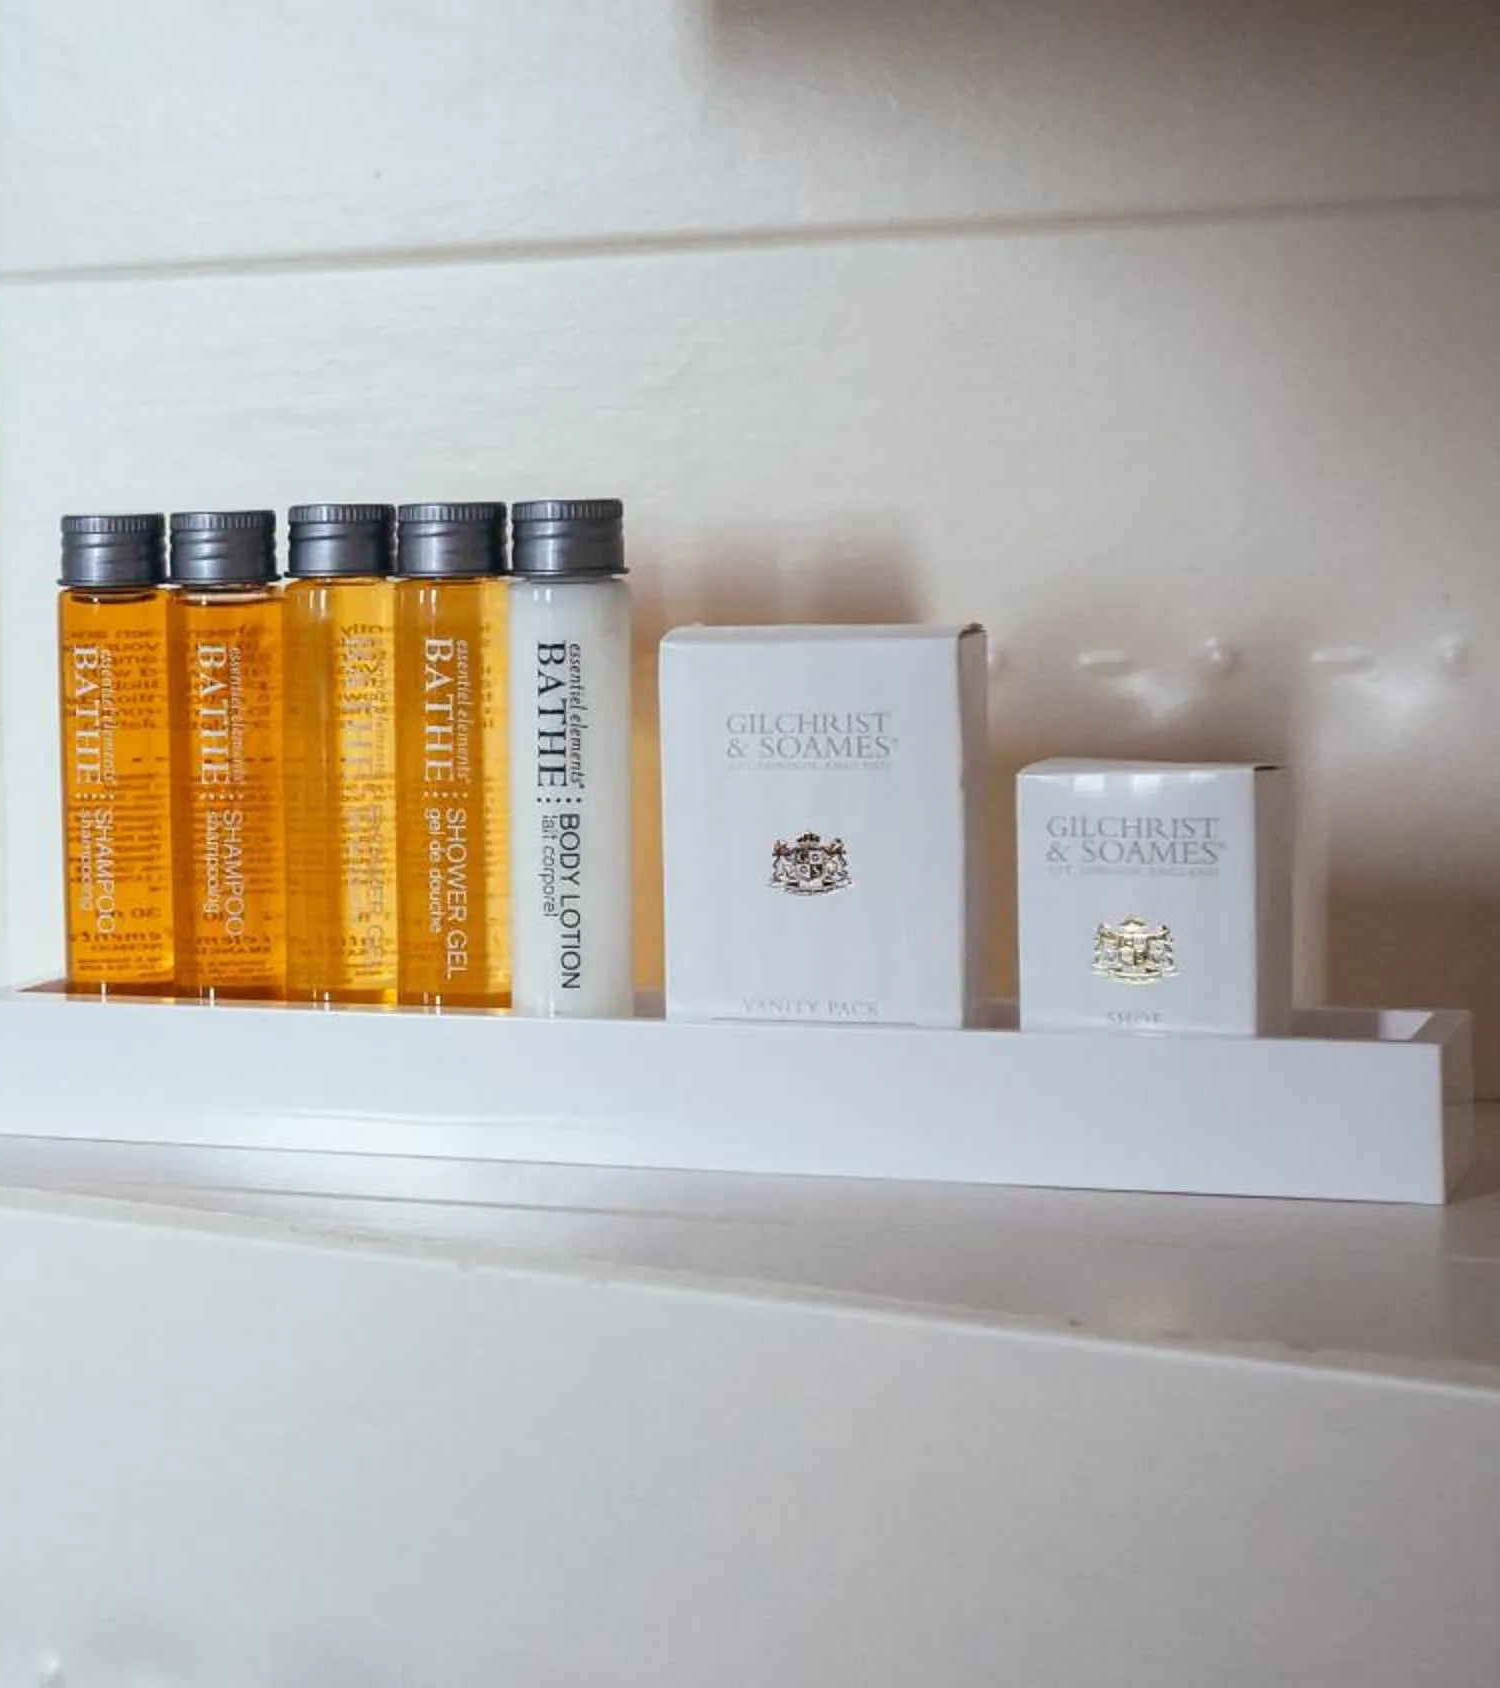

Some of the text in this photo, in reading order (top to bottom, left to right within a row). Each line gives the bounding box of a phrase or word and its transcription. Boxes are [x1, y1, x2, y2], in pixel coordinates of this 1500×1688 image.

[73, 645, 102, 784] BATHE
[198, 643, 229, 784] BATHE
[424, 638, 454, 783] BATHE
[537, 639, 567, 786] BATHE
[726, 712, 892, 734] GILCHRIST
[726, 737, 746, 759] &
[95, 809, 116, 934] SHAMPOO
[223, 809, 245, 937] SHAMPOO
[425, 807, 446, 934] gel de douche
[537, 815, 559, 917] lait corporel
[1045, 815, 1221, 839] GILCHRIST
[1045, 840, 1068, 863] &
[446, 807, 468, 980] SHOWER GEL
[559, 813, 582, 989] BODY LOTION
[742, 996, 880, 1017] VANITY PACK
